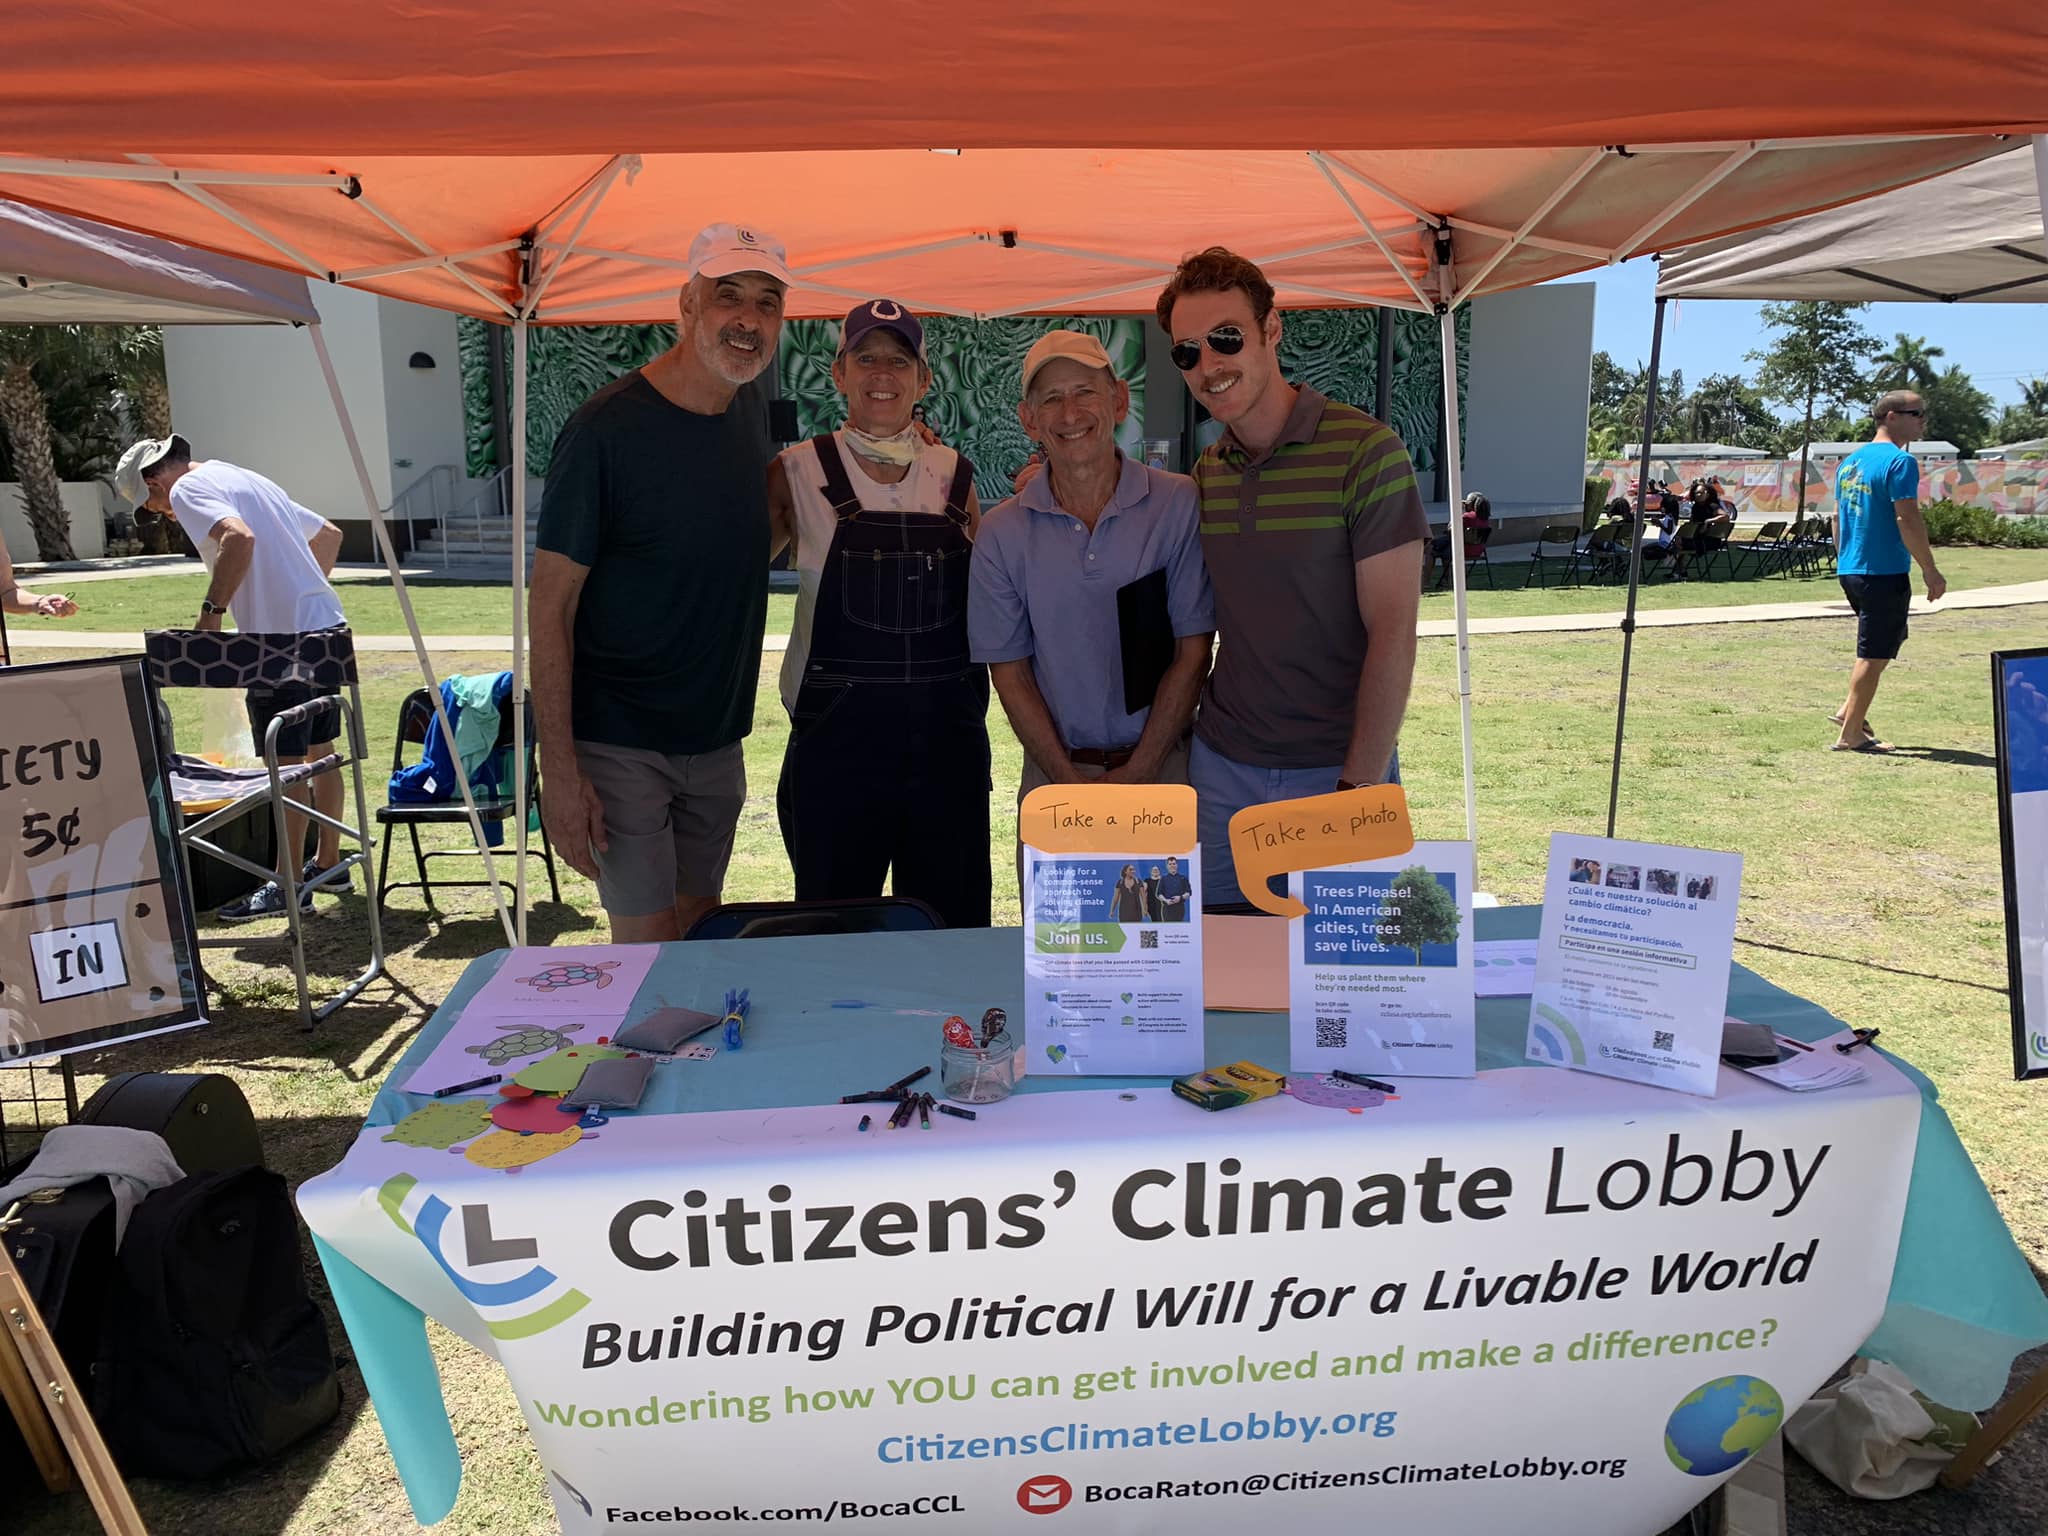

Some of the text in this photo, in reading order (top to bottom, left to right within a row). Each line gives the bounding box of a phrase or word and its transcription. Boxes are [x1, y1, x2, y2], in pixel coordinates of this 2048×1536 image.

[1040, 803, 1173, 833] Take a photo
[1241, 802, 1398, 852] Take a photo
[22, 806, 80, 858] 5¢
[1043, 868, 1076, 877] Looking
[1077, 868, 1090, 876] for
[1075, 898, 1105, 906] climate
[1313, 885, 1412, 899] Trees Please!
[1567, 886, 1698, 911] ¿Cuál es nuestra solución al
[1314, 904, 1401, 917] In American
[1568, 898, 1652, 917] cambio climático?
[1314, 921, 1401, 936] cities, trees
[1564, 913, 1634, 931] La democracia.
[1046, 930, 1109, 946] Join us.
[1314, 940, 1390, 953] save lives.
[1570, 926, 1618, 939] necesitamos
[1629, 934, 1684, 949] participación.
[52, 941, 104, 985] IN
[1564, 939, 1596, 951] Participa
[1621, 948, 1644, 958] sesión
[1645, 952, 1688, 965] informativa
[1315, 973, 1426, 984] Help us plant them where
[1315, 983, 1408, 993] they're needed most.
[608, 1129, 1832, 1271] Citizens' Climate Lobby
[582, 1239, 1820, 1369] Building Political Will for a Livable World
[533, 1318, 1779, 1430] Wondering how YOU can get involved and make a difference?
[877, 1410, 1397, 1463] CitizensClimateLobby.org
[1085, 1456, 1628, 1503] BocaRaton@CitizensClimateLobby.org
[606, 1494, 965, 1523] Facebook.com/BocaCCL
